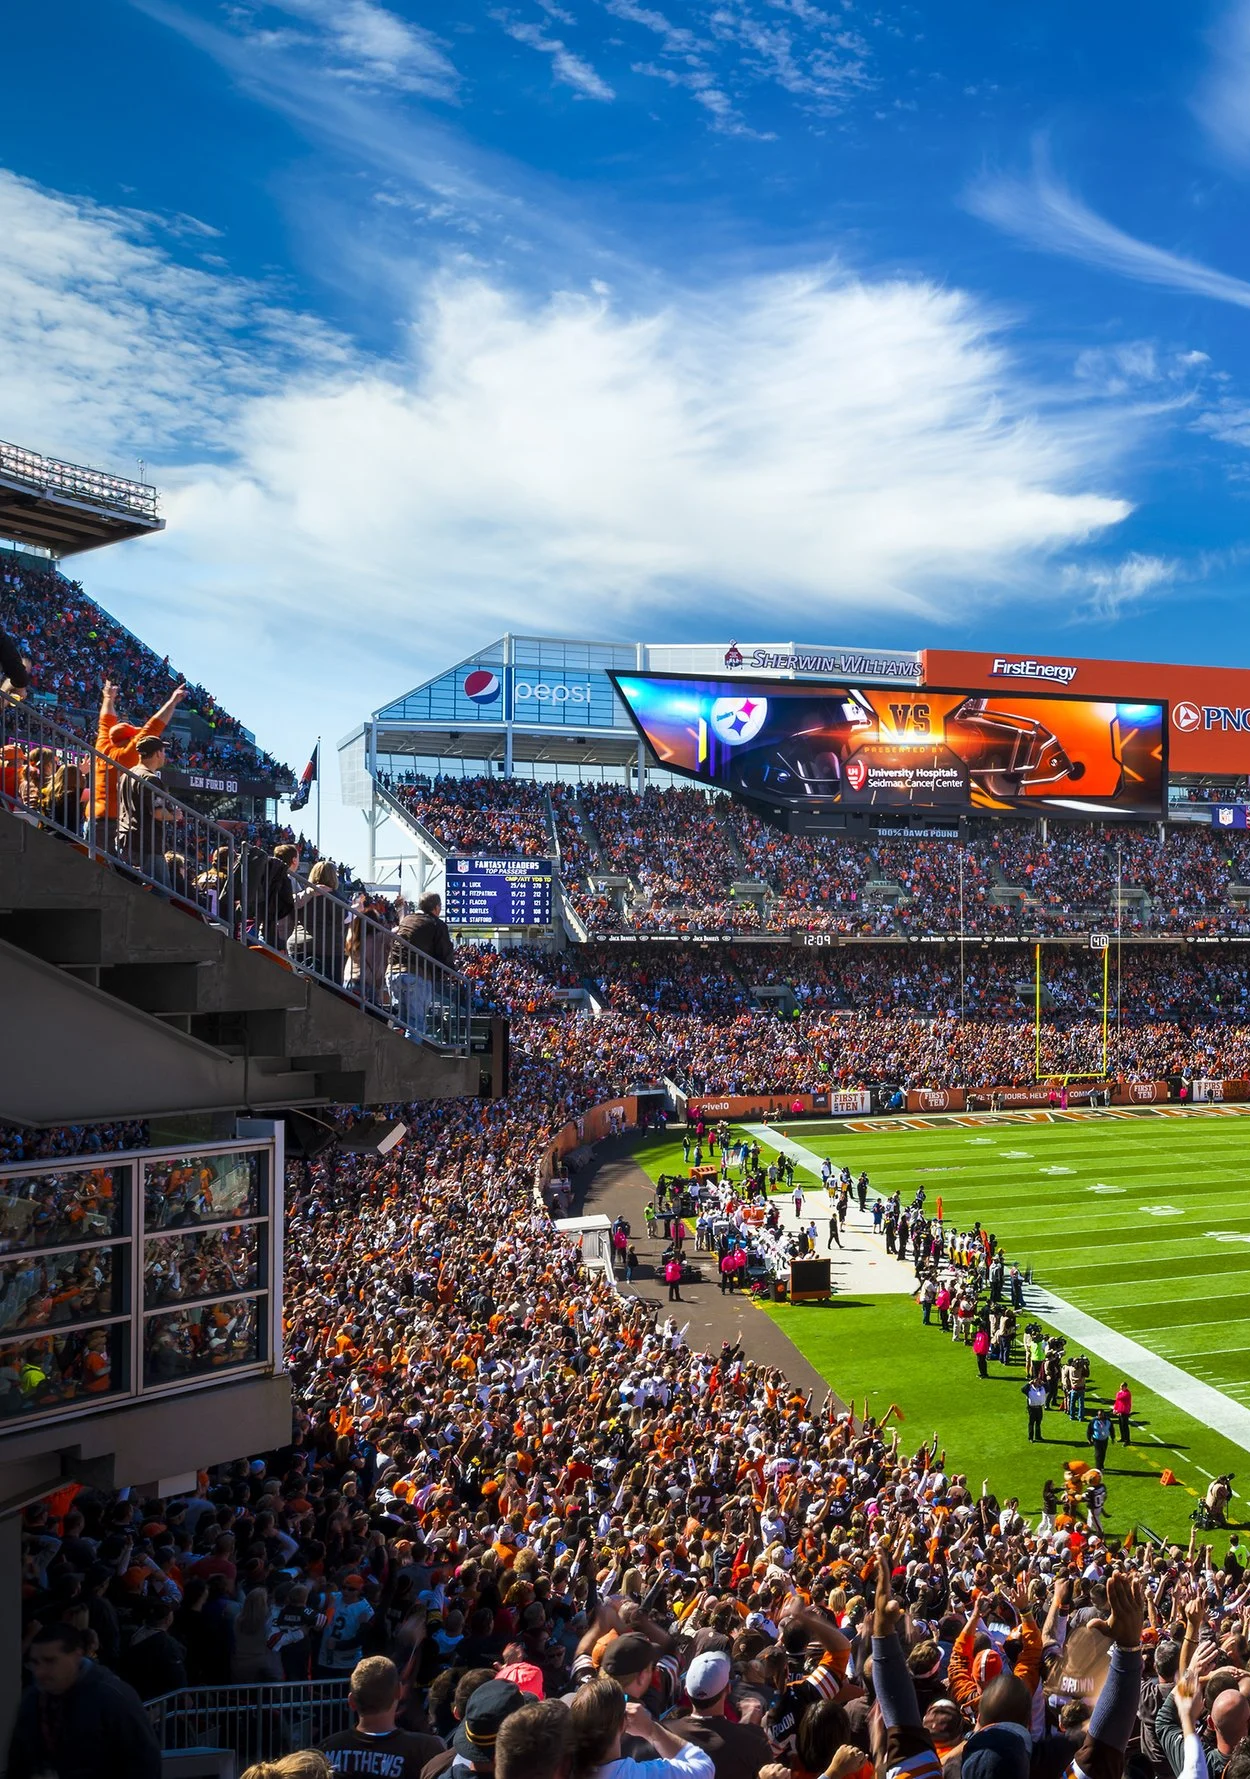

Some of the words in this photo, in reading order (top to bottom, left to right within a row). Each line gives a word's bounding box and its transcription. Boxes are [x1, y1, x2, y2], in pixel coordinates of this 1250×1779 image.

[750, 649, 924, 677] SHERWIN-WILLIAMS
[991, 658, 1078, 682] FirstEnergy
[513, 681, 591, 705] pepsi
[889, 703, 931, 737] VS
[868, 768, 914, 779] University
[916, 768, 958, 779] Hospitals
[189, 776, 204, 787] LEN
[205, 779, 224, 790] FORD
[226, 781, 238, 793] 80
[868, 779, 903, 788] Seidman
[905, 779, 934, 788] Cancer
[935, 779, 963, 788] Center
[878, 829, 901, 837] 100%
[903, 829, 929, 838] DAWG
[930, 830, 959, 838] POUND
[474, 861, 506, 869] FANTASY
[507, 861, 540, 870] LEADERS
[803, 935, 831, 945] 12:09
[1093, 936, 1108, 947] 40
[834, 1093, 859, 1102] FIRST
[924, 1091, 945, 1099] FIRST
[702, 1101, 729, 1111] give10
[839, 1102, 858, 1111] TEN
[1061, 1676, 1095, 1693] BROWN
[324, 1749, 405, 1779] MATTHEWS
